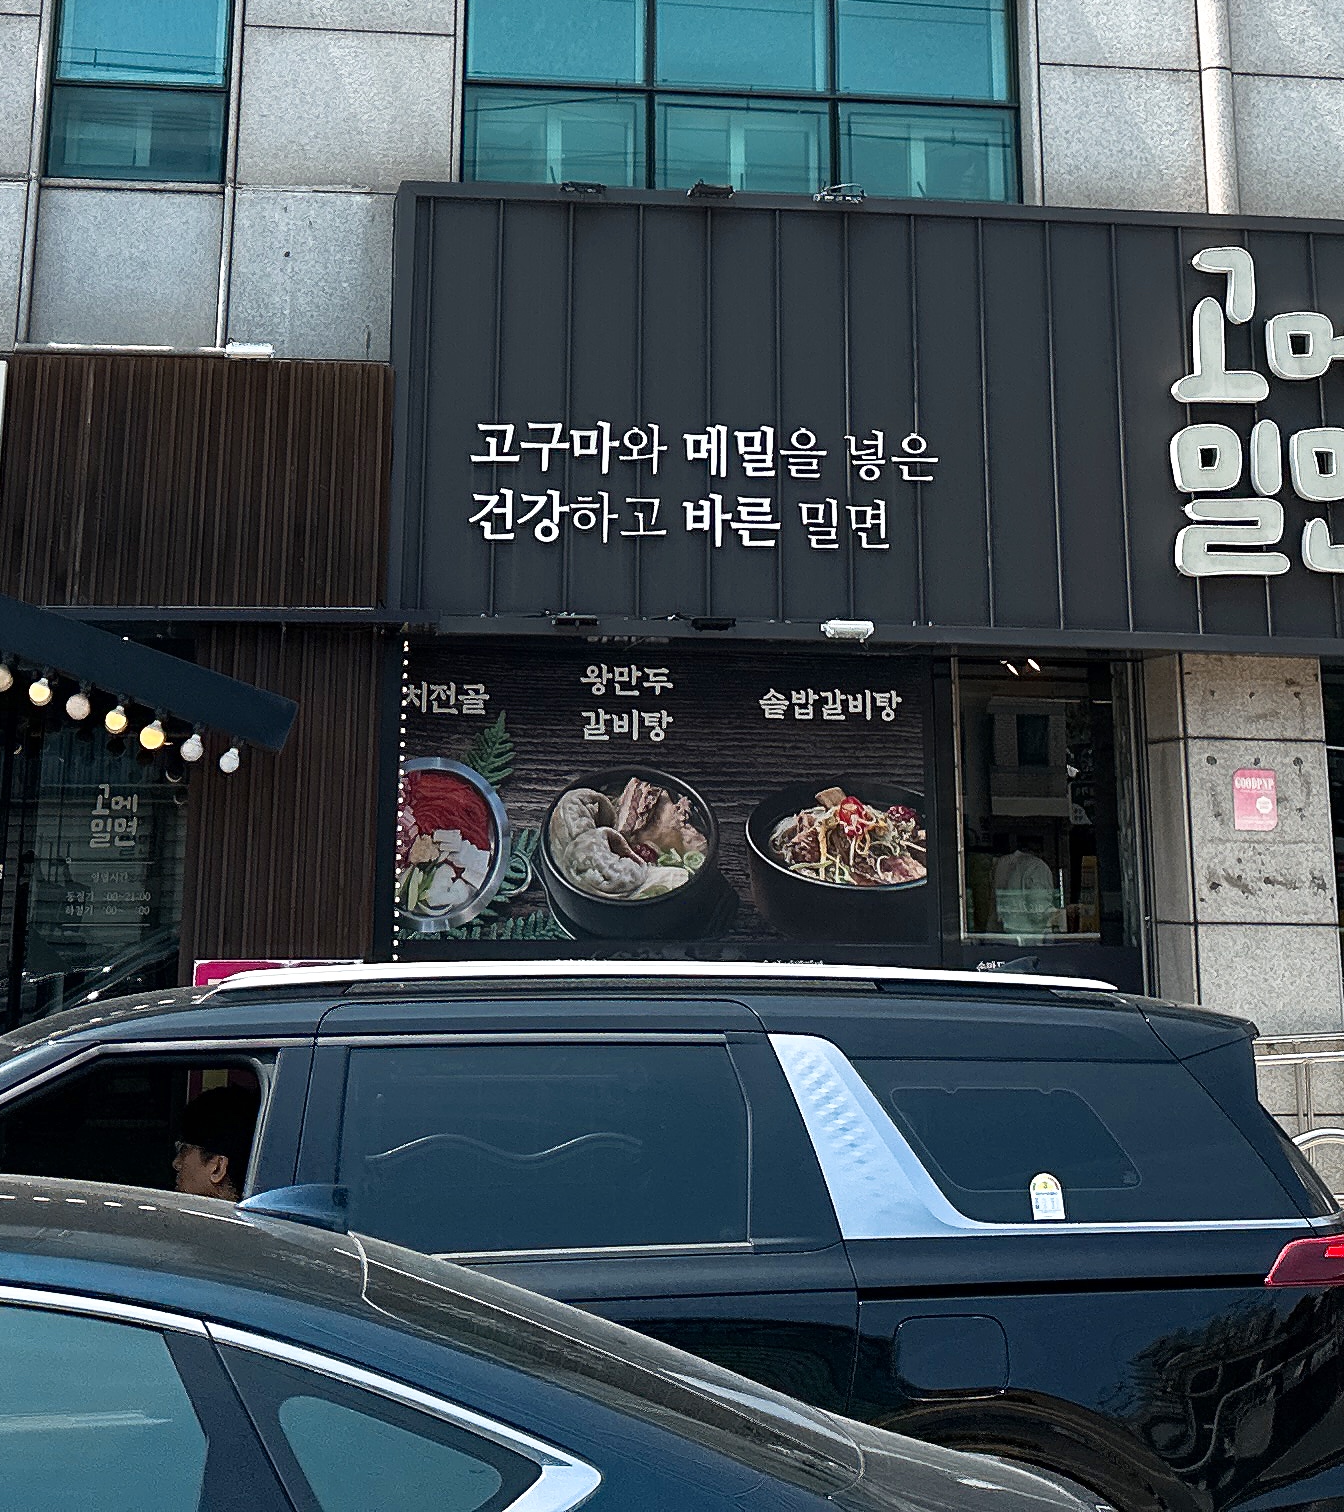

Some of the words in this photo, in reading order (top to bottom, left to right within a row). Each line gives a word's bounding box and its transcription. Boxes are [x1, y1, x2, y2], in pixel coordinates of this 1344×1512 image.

[469, 420, 668, 476] 고구마와
[683, 424, 827, 479] 메밀을
[844, 429, 939, 482] 넣은
[468, 488, 668, 544] 건강하고
[681, 492, 782, 548] 바른
[798, 498, 891, 549] 밀면
[580, 663, 674, 696] 왕만두
[758, 688, 903, 722] 솥밥갈비탕
[581, 709, 673, 742] 갈비탕
[91, 783, 138, 815] 고메
[89, 816, 138, 848] 밀면
